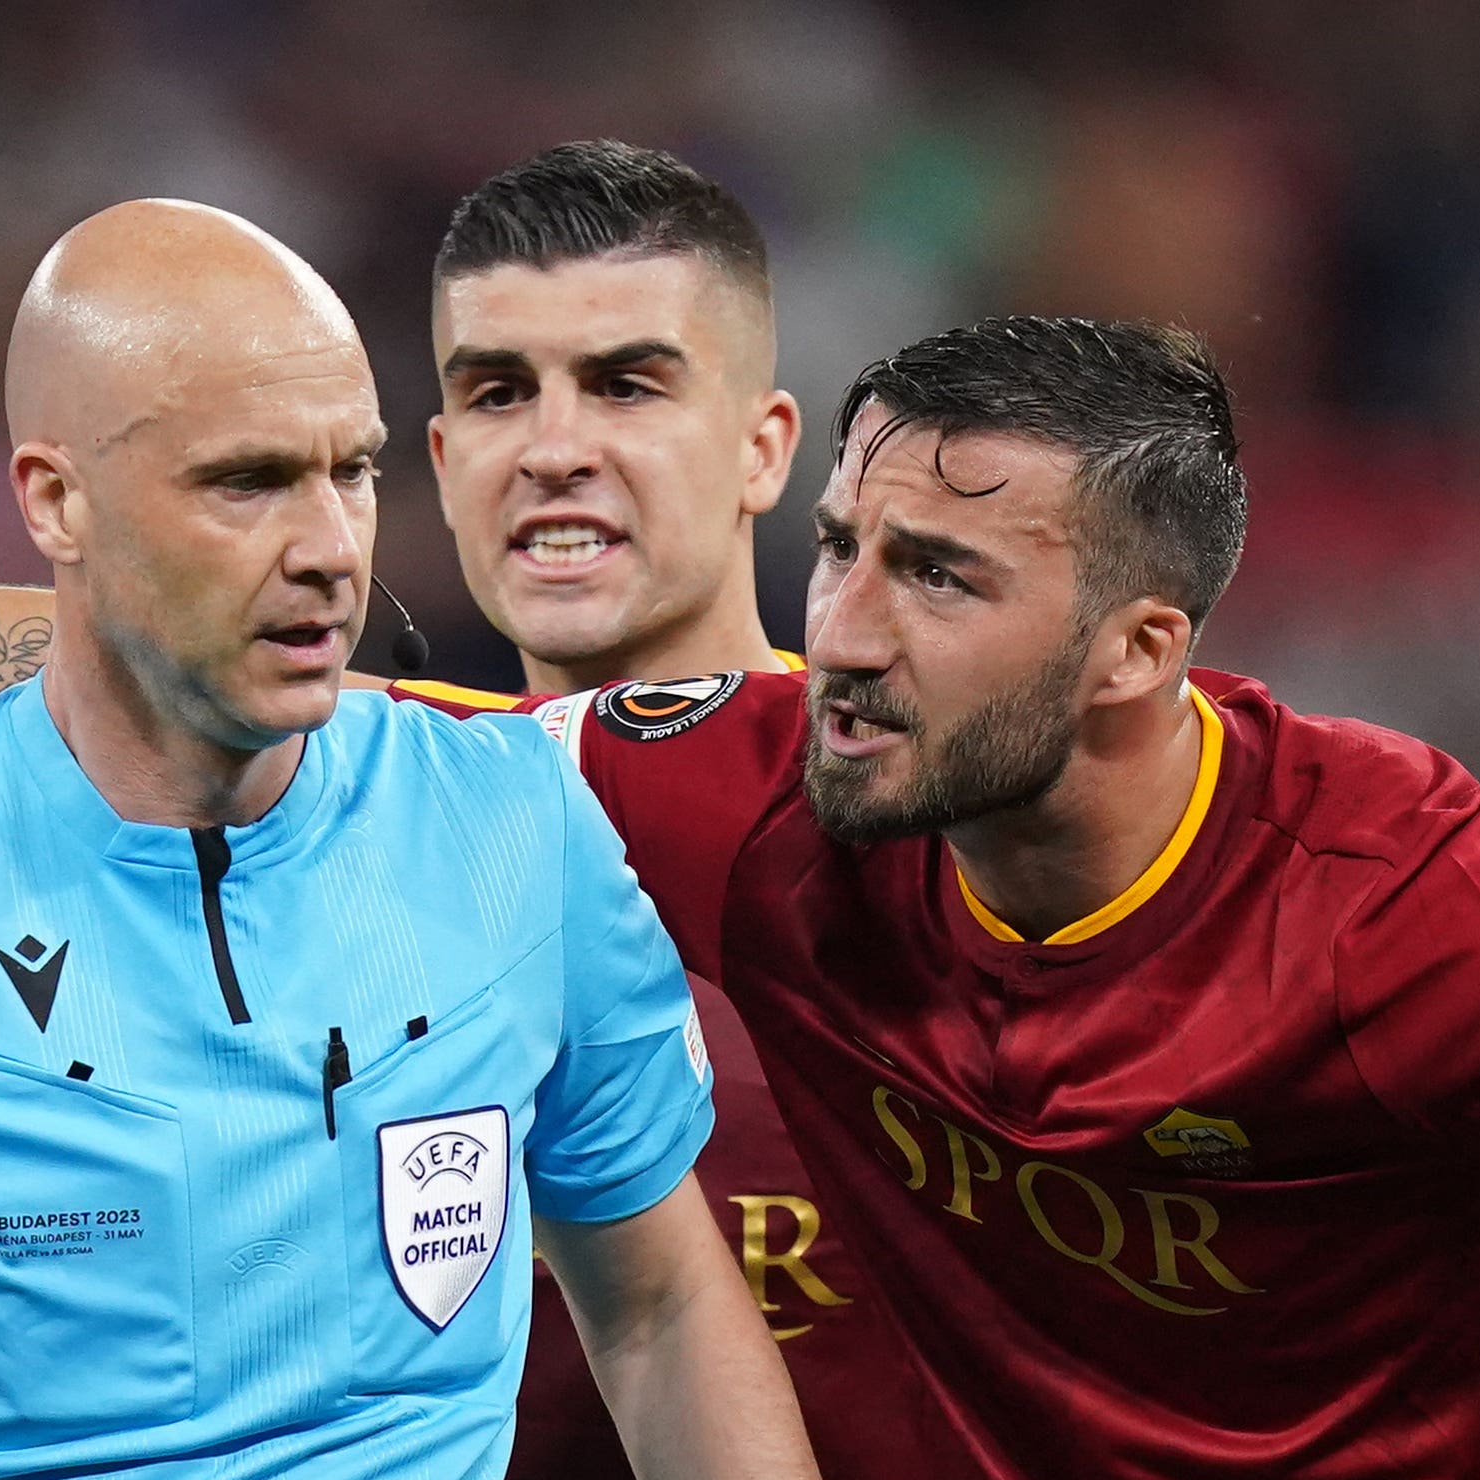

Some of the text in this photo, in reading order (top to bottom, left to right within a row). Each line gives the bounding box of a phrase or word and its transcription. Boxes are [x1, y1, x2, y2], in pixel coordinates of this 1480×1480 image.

[641, 720, 690, 740] LEAGUE
[408, 1141, 480, 1181] UEFA
[872, 1086, 1267, 1317] SPQR
[96, 1209, 140, 1225] 2023
[413, 1202, 482, 1233] MATCH
[30, 1231, 91, 1245] BUDAPEST
[103, 1230, 115, 1241] 31
[118, 1228, 145, 1240] MAY
[25, 1249, 38, 1258] FC
[51, 1248, 64, 1257] AS
[66, 1247, 94, 1256] ROMA
[404, 1233, 488, 1266] OFFICIAL
